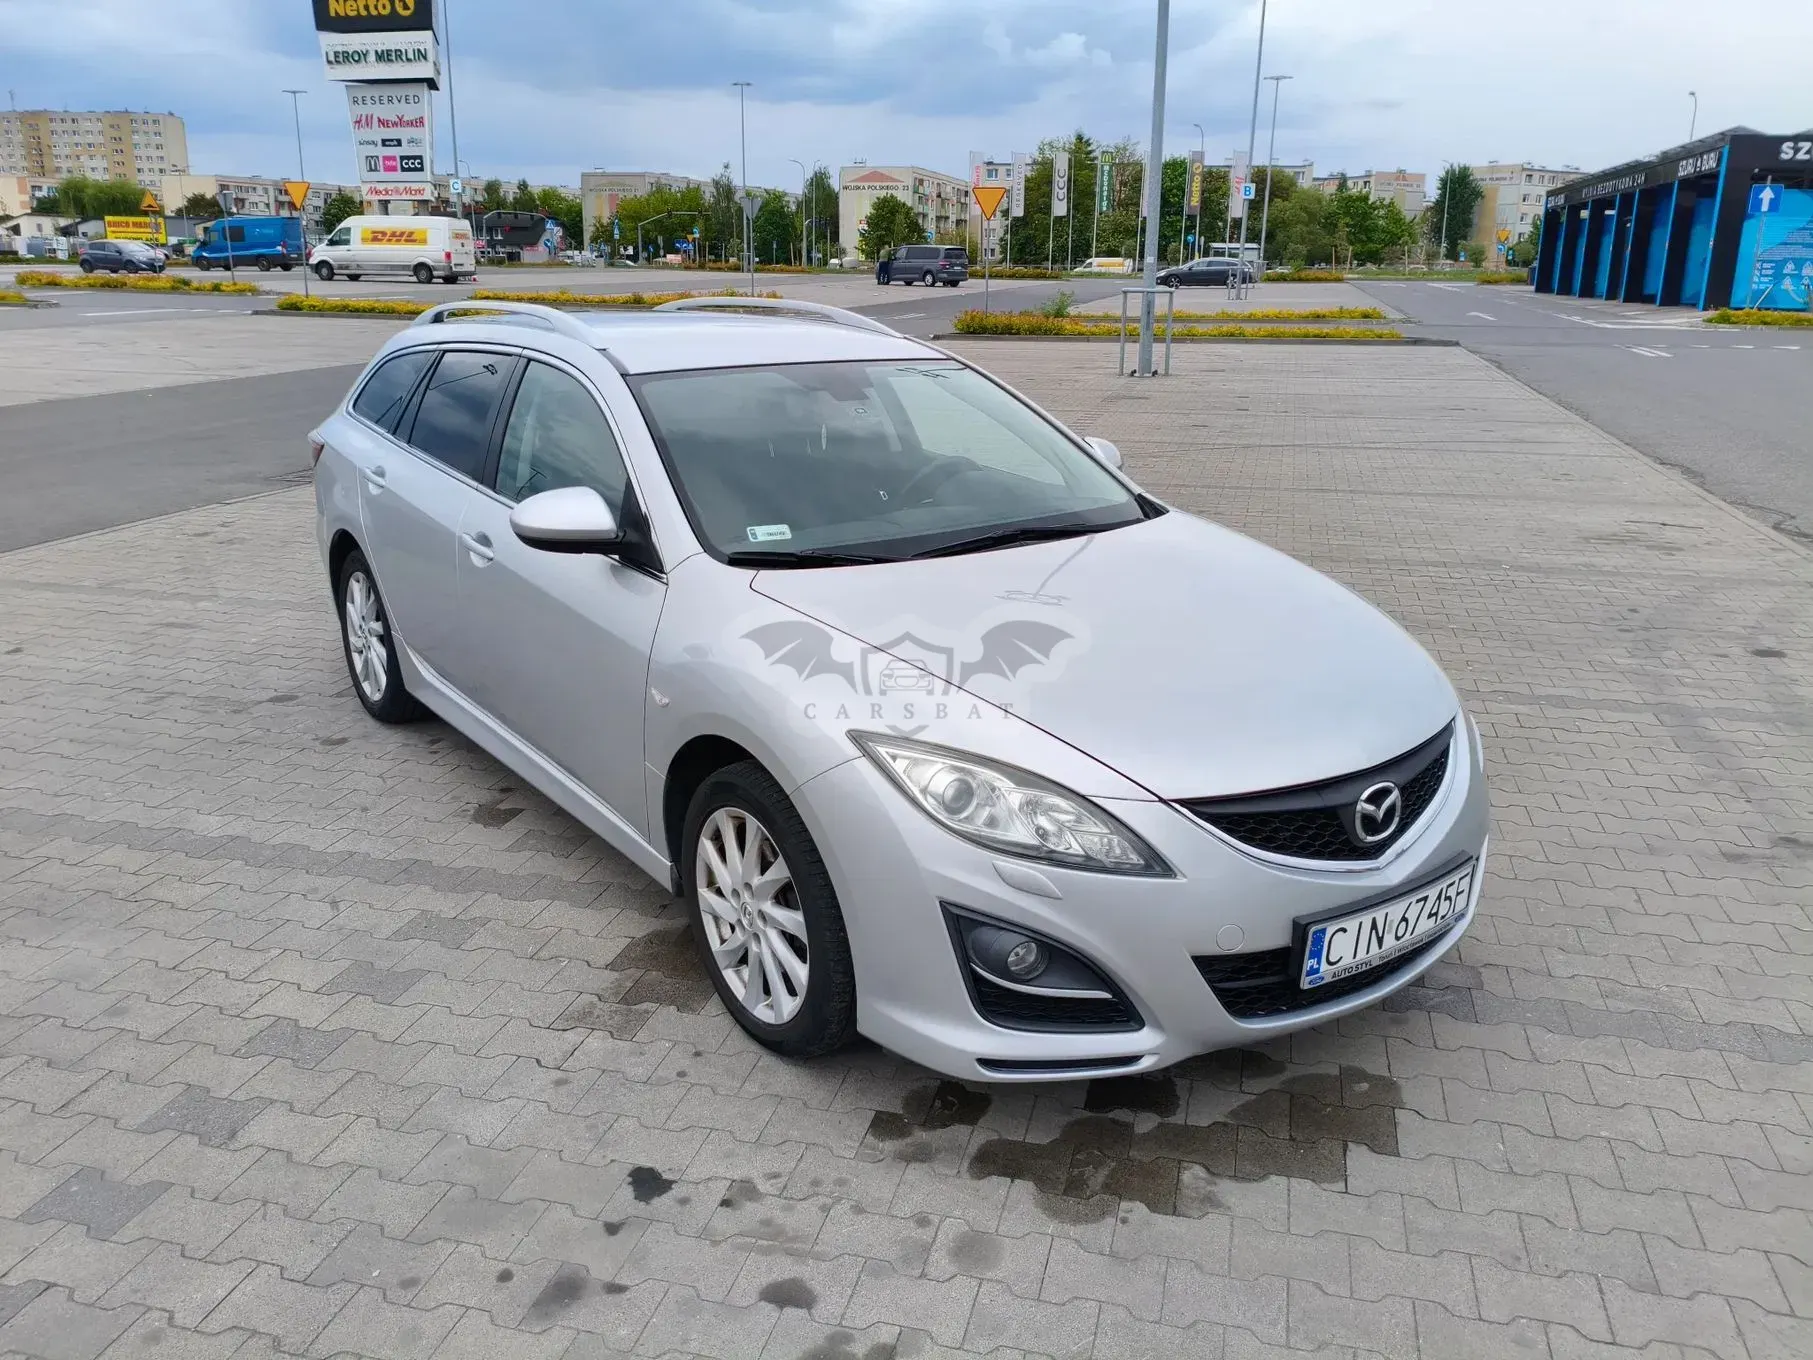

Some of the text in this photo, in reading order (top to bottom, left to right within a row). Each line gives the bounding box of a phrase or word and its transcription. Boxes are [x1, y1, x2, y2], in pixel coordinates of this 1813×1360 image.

[328, 0, 391, 16] Netto
[326, 48, 428, 65] LEROY MERLIN
[352, 94, 420, 106] RESERVED
[1779, 141, 1813, 160] SZ
[402, 159, 421, 168] CCC
[451, 181, 460, 191] C
[867, 184, 899, 192] POLSKIEGO
[1056, 168, 1066, 202] CCC
[1190, 174, 1201, 206] Netto
[1243, 185, 1252, 197] B
[370, 230, 418, 243] DHL
[1325, 871, 1470, 966] CIN 6745F
[1307, 958, 1319, 971] PL
[1331, 959, 1374, 980] AUTO STYL
